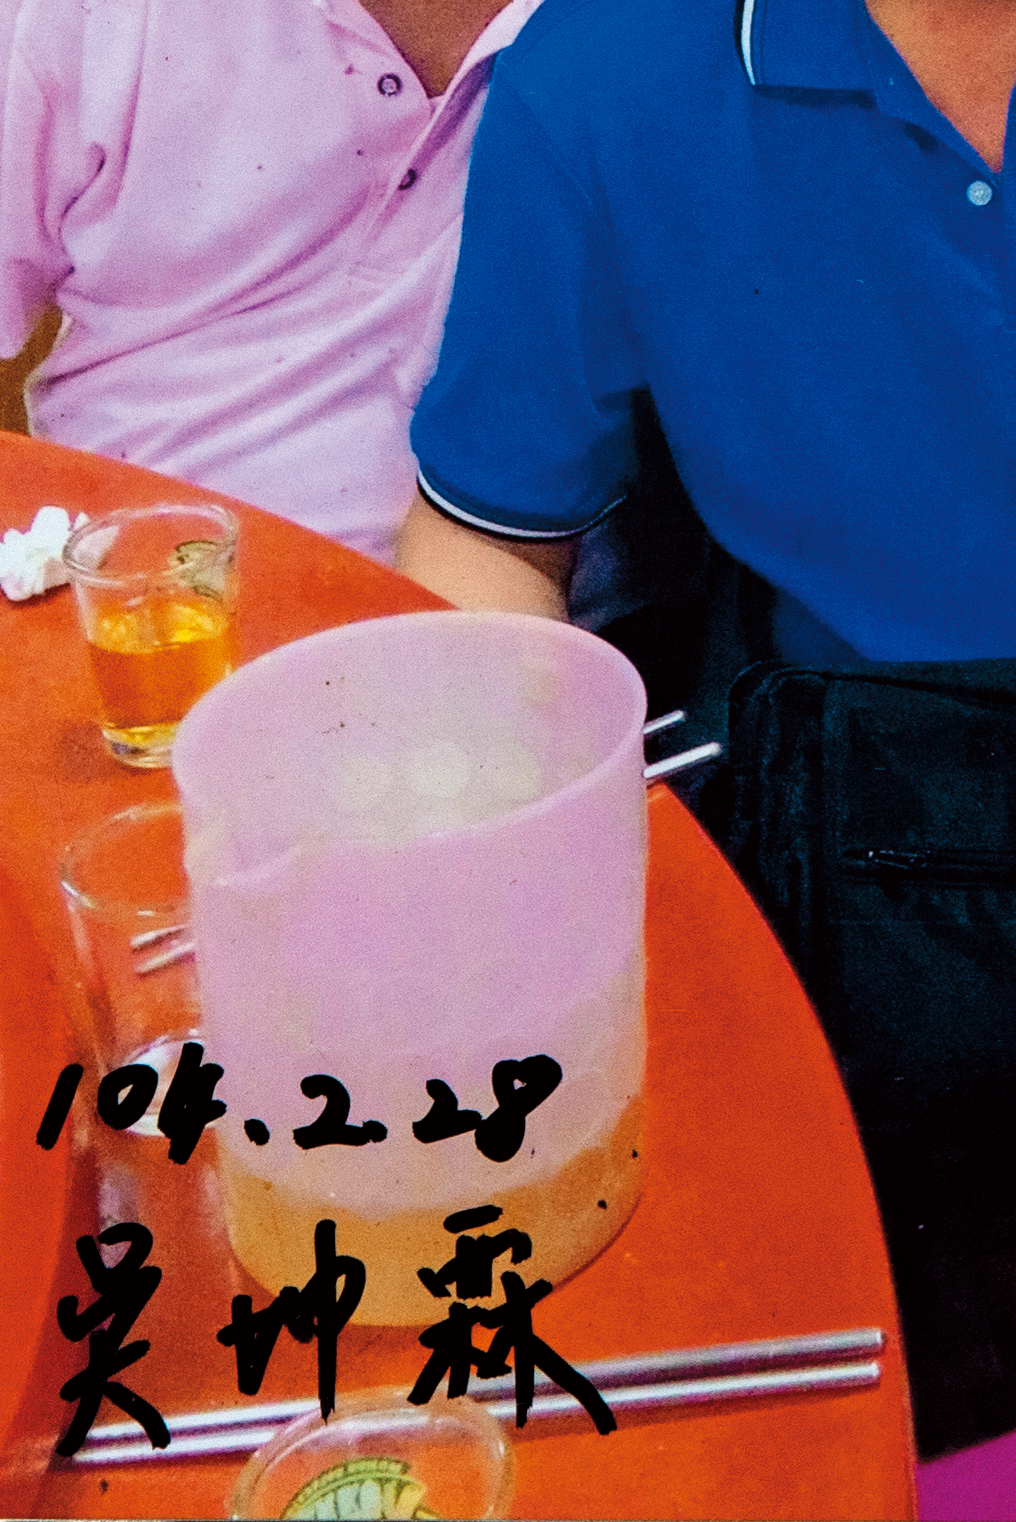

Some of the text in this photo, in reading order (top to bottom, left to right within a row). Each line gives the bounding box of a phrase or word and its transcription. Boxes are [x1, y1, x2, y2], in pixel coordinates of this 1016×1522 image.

[36, 1041, 563, 1165] 104.2.28
[55, 1204, 618, 1458] 吳坤霖
